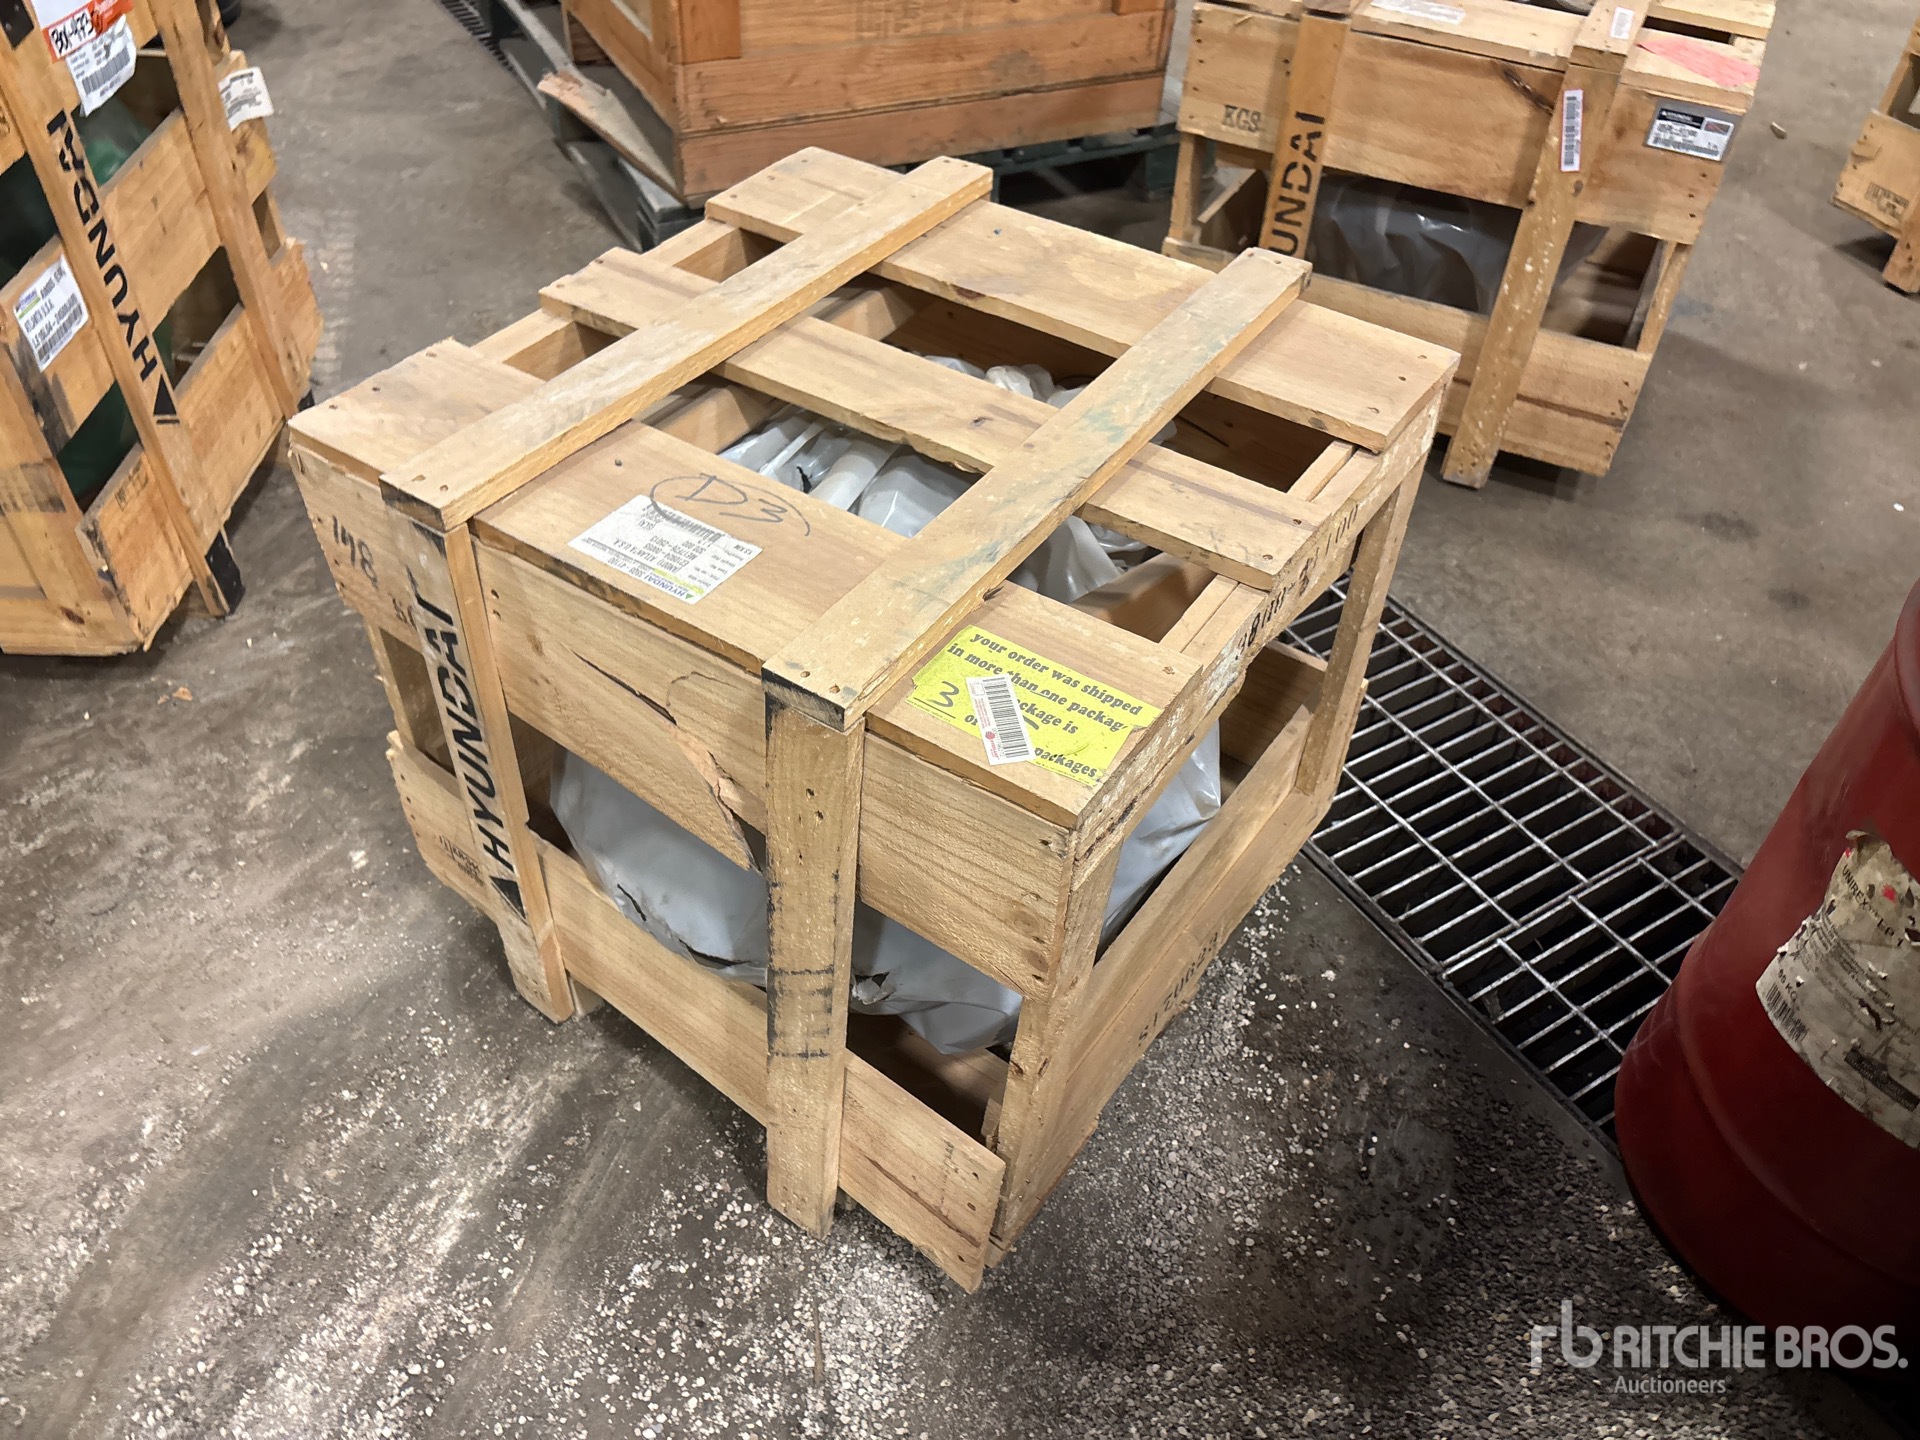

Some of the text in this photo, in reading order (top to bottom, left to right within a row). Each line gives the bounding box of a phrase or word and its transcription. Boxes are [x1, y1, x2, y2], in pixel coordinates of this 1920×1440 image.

[1223, 105, 1262, 132] KGS
[1269, 111, 1325, 257] UNDAI
[46, 110, 159, 380] HYUNDAI
[642, 574, 686, 596] HYUNDAI
[926, 680, 961, 708] 3
[946, 642, 968, 657] in
[965, 653, 1004, 675] more
[1038, 688, 1068, 705] one
[1068, 701, 1129, 732] packag
[969, 633, 1143, 716] your order was shipped
[406, 563, 515, 873] HYUNDAI
[1016, 699, 1080, 734] ckage is
[1031, 743, 1098, 781] packages
